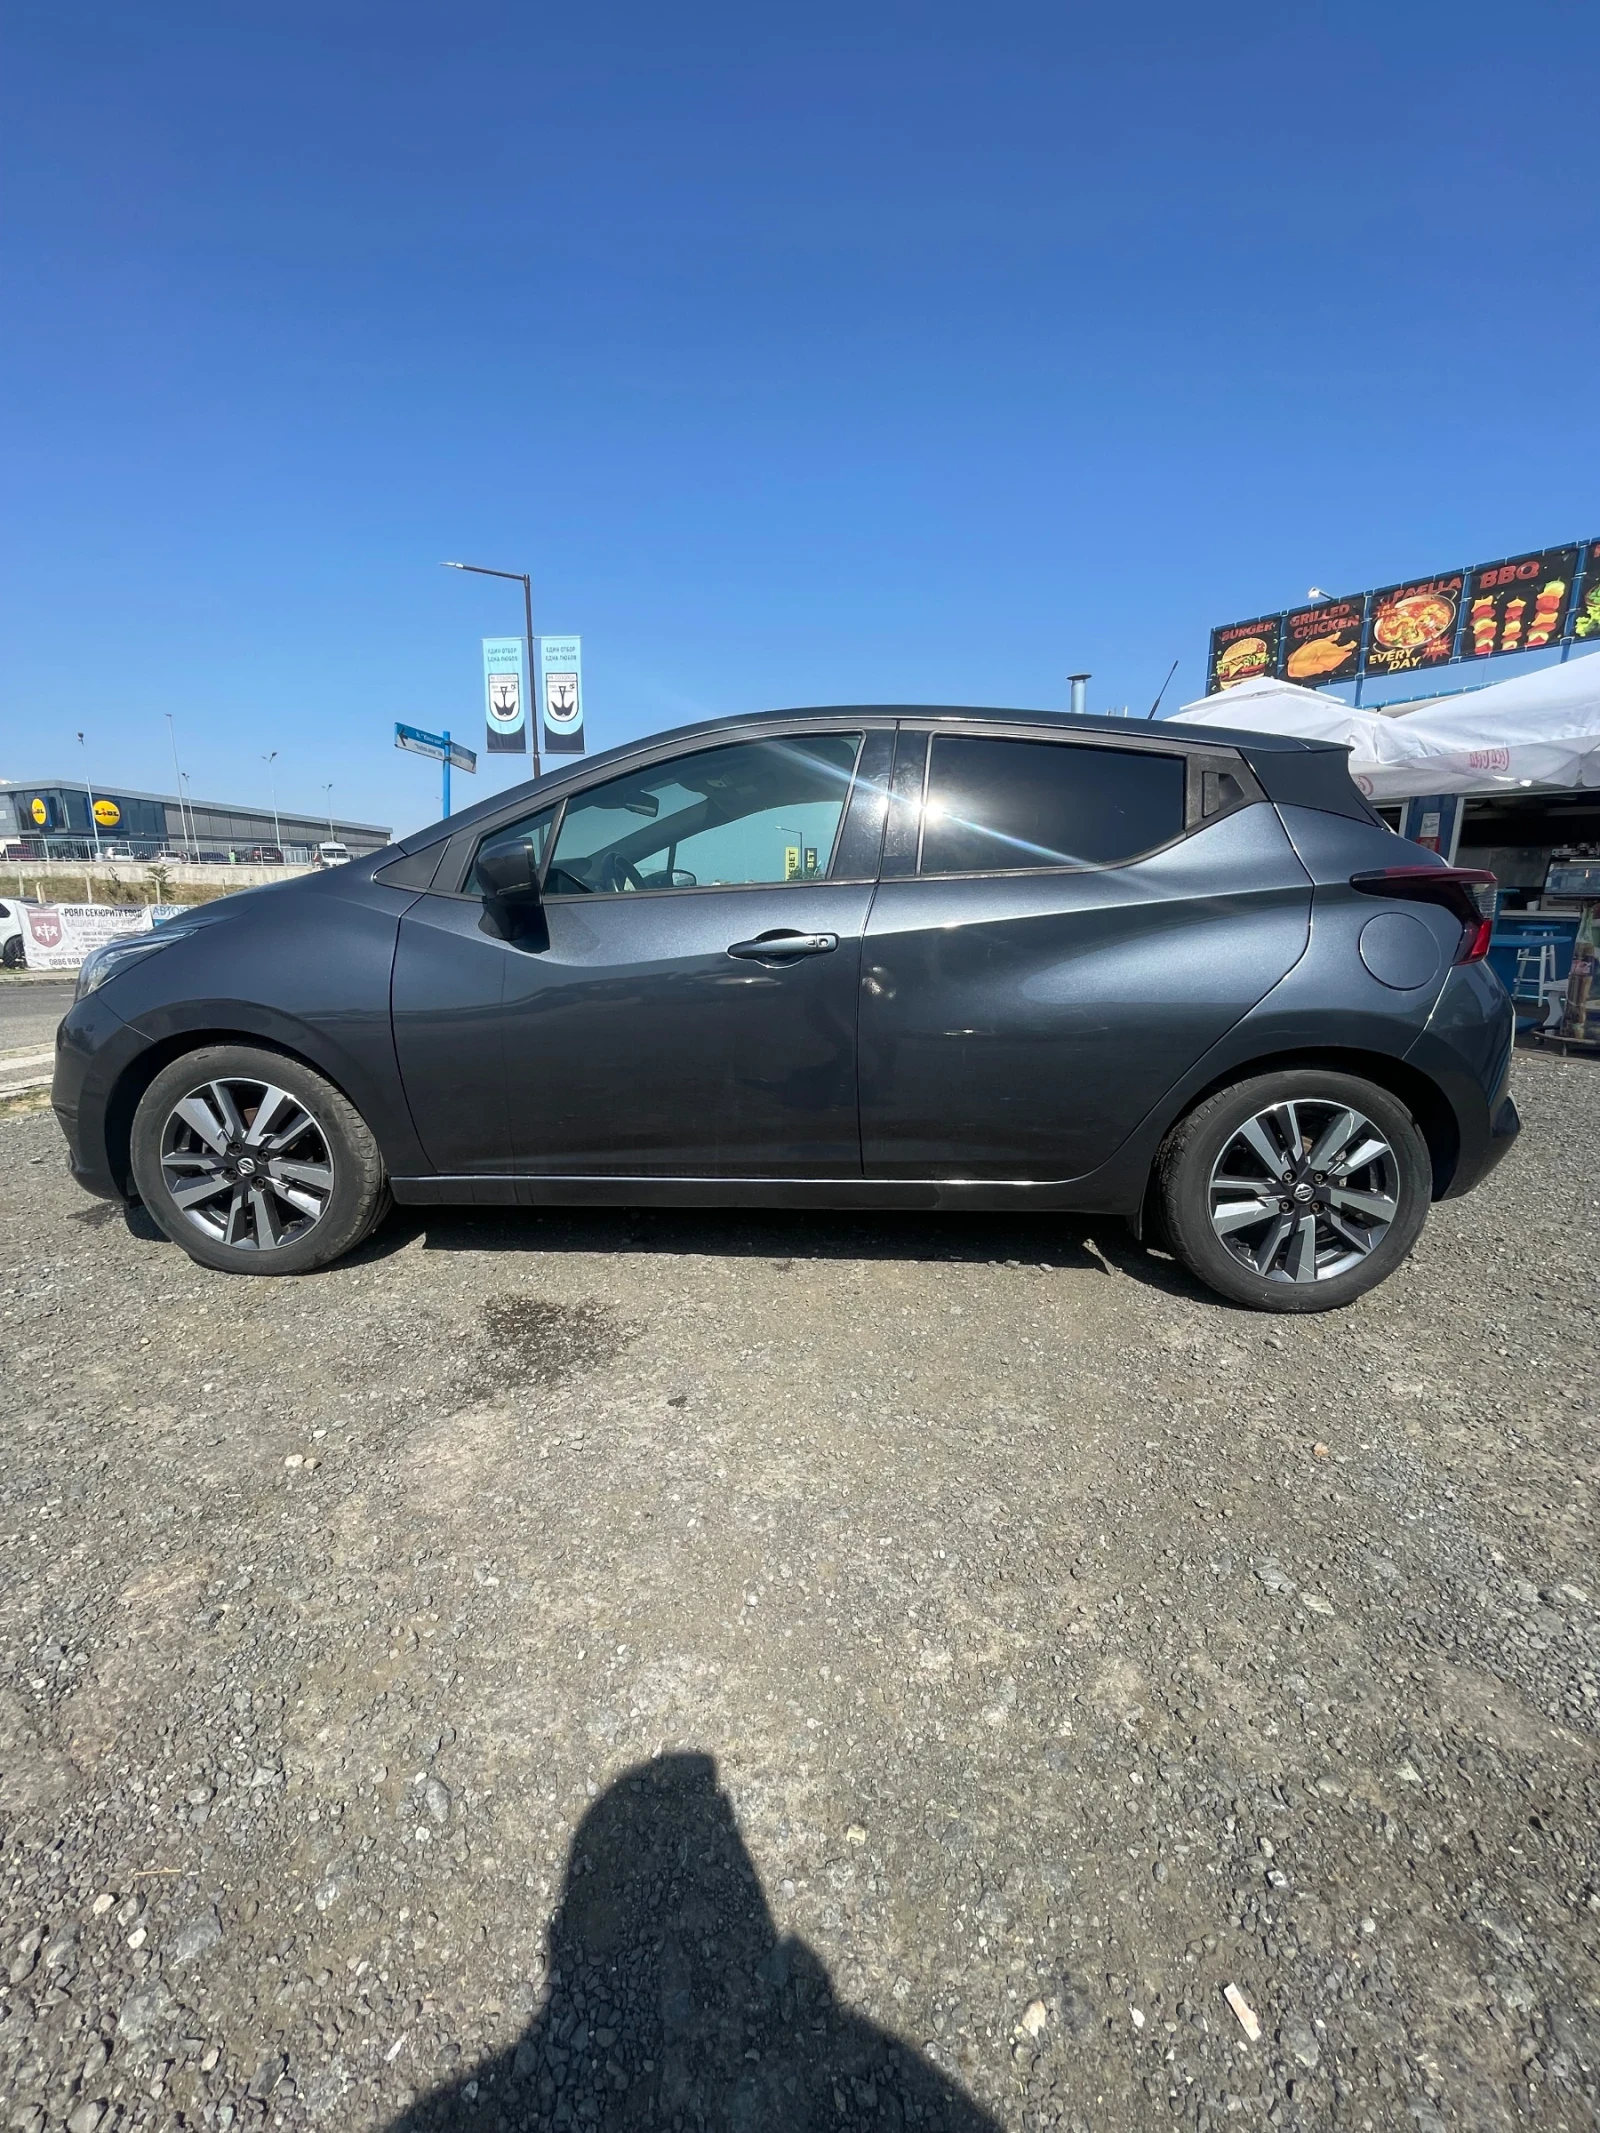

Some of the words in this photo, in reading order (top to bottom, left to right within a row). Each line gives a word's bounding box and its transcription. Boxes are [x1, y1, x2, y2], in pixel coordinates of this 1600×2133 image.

[1480, 561, 1539, 589] BBQ
[1393, 577, 1461, 602] PAELLA
[1290, 604, 1350, 627] GRILLED
[1222, 621, 1274, 641] BURGER
[1294, 615, 1360, 639] CHICKEN
[1369, 648, 1414, 665] EVERY
[1389, 656, 1420, 671] DAY
[95, 807, 119, 817] LIDL
[64, 908, 84, 917] РОЯЛ
[85, 908, 123, 918] СЕКЮРИТИ
